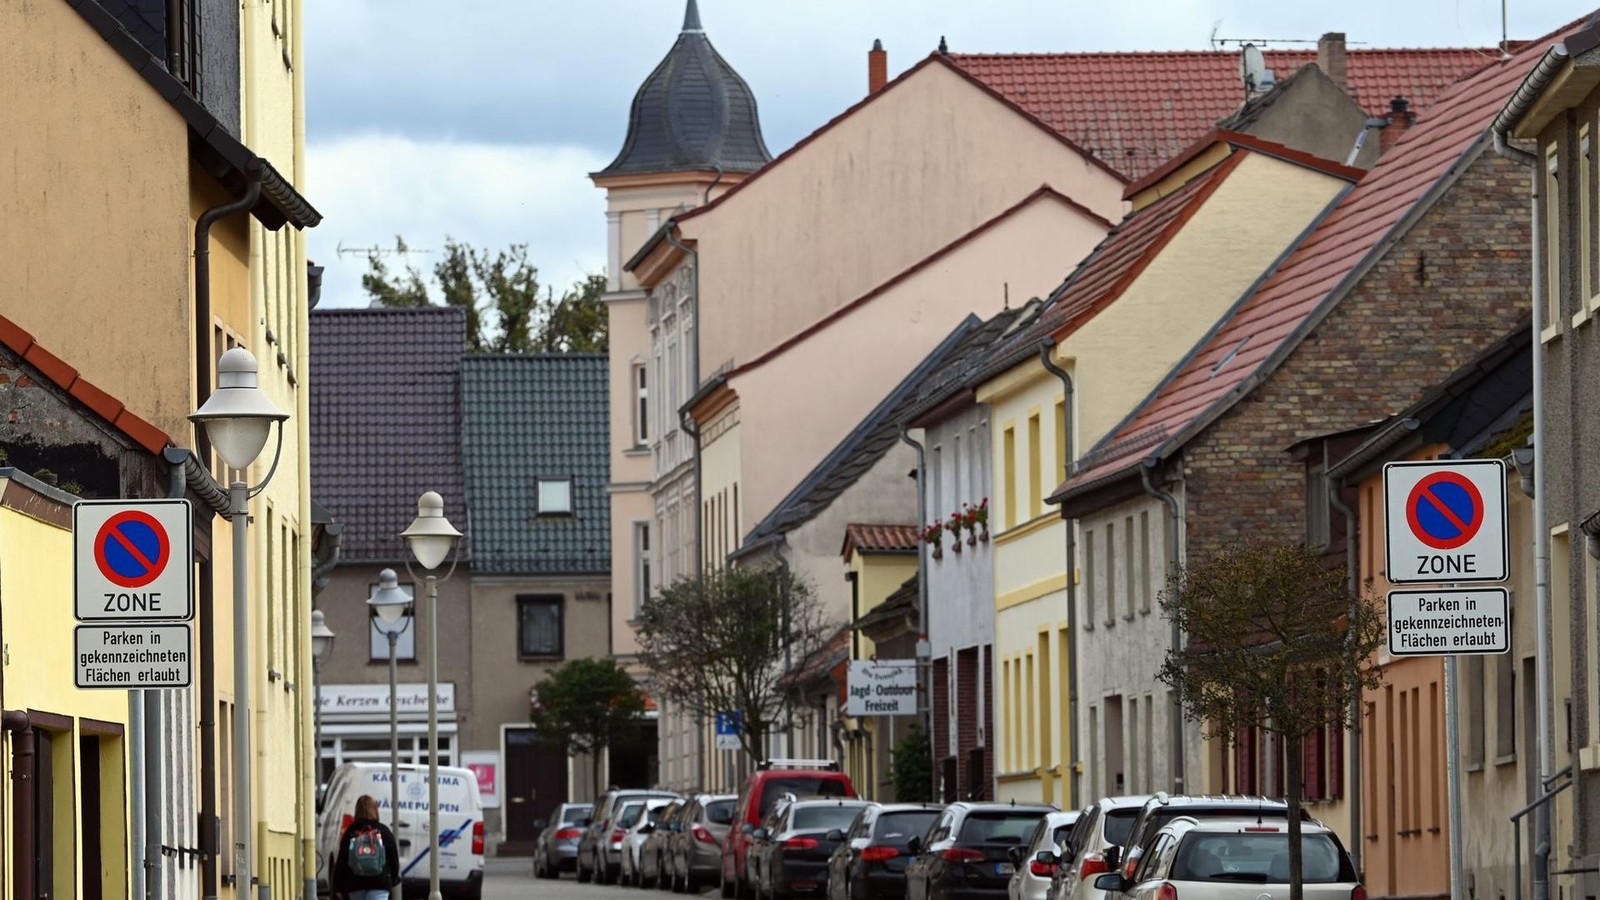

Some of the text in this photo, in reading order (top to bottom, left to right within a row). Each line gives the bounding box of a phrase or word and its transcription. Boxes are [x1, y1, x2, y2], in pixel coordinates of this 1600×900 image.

[1417, 554, 1477, 574] ZONE
[103, 593, 162, 612] ZONE
[1418, 596, 1476, 612] Parken in
[1395, 614, 1501, 634] gekennzeichneten
[103, 630, 161, 645] Parken in
[1401, 631, 1496, 648] Flächen erlaubt
[80, 649, 186, 668] gekennzeichneten
[86, 667, 180, 682] Flächen erlaubt
[850, 684, 871, 699] Jagd
[336, 695, 380, 706] Kerzen
[865, 699, 899, 712] Freizeit
[372, 773, 460, 786] KÄE KIMA
[375, 799, 460, 813] ÄMEPUPEN
